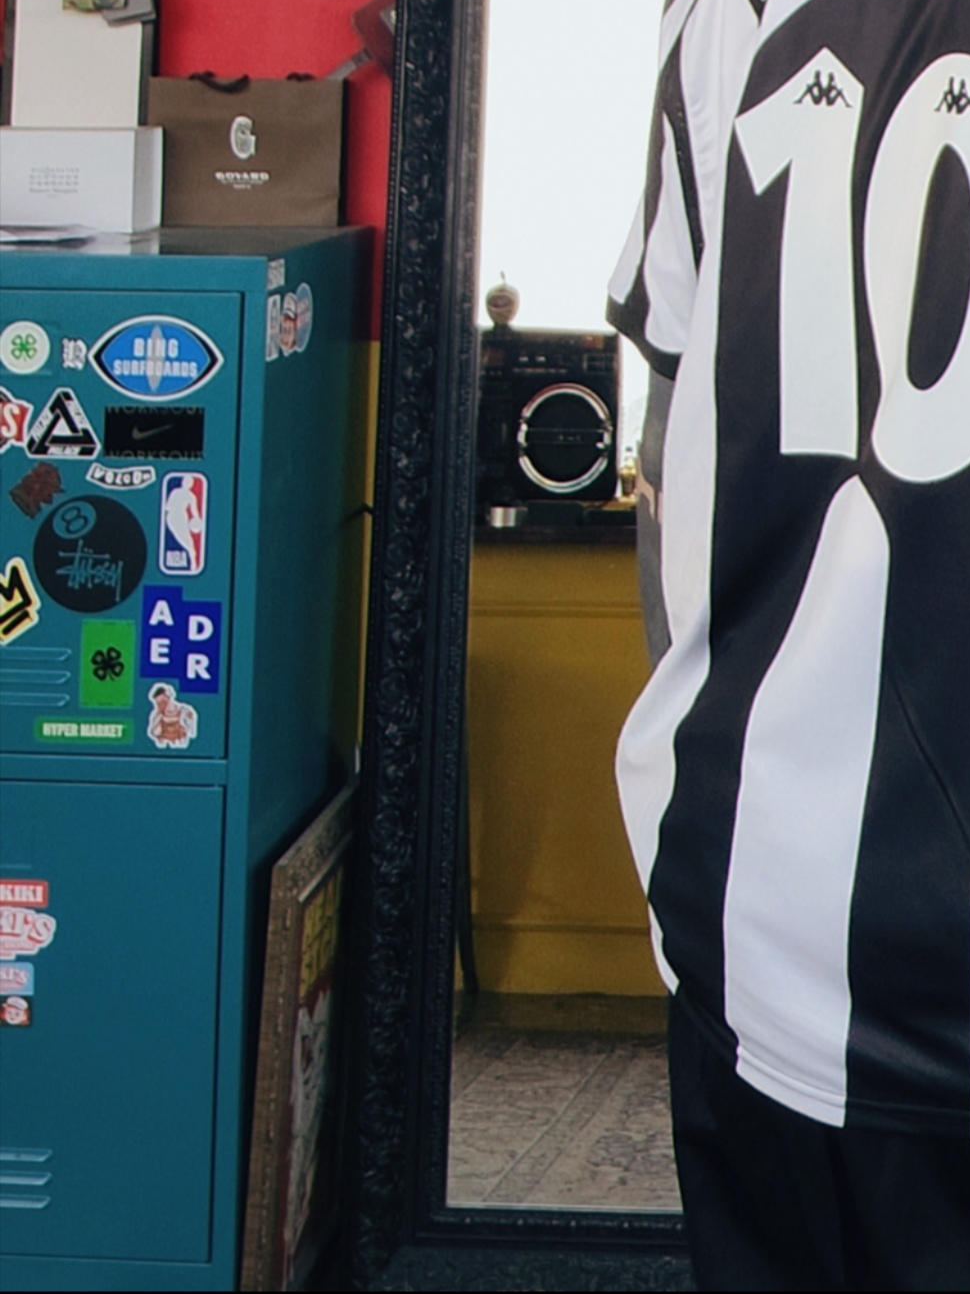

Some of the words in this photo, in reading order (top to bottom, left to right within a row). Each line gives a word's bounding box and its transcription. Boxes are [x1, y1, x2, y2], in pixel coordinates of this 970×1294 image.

[112, 359, 198, 378] SURFBOARDS
[43, 722, 78, 737] HYPER
[80, 723, 123, 738] MARKET
